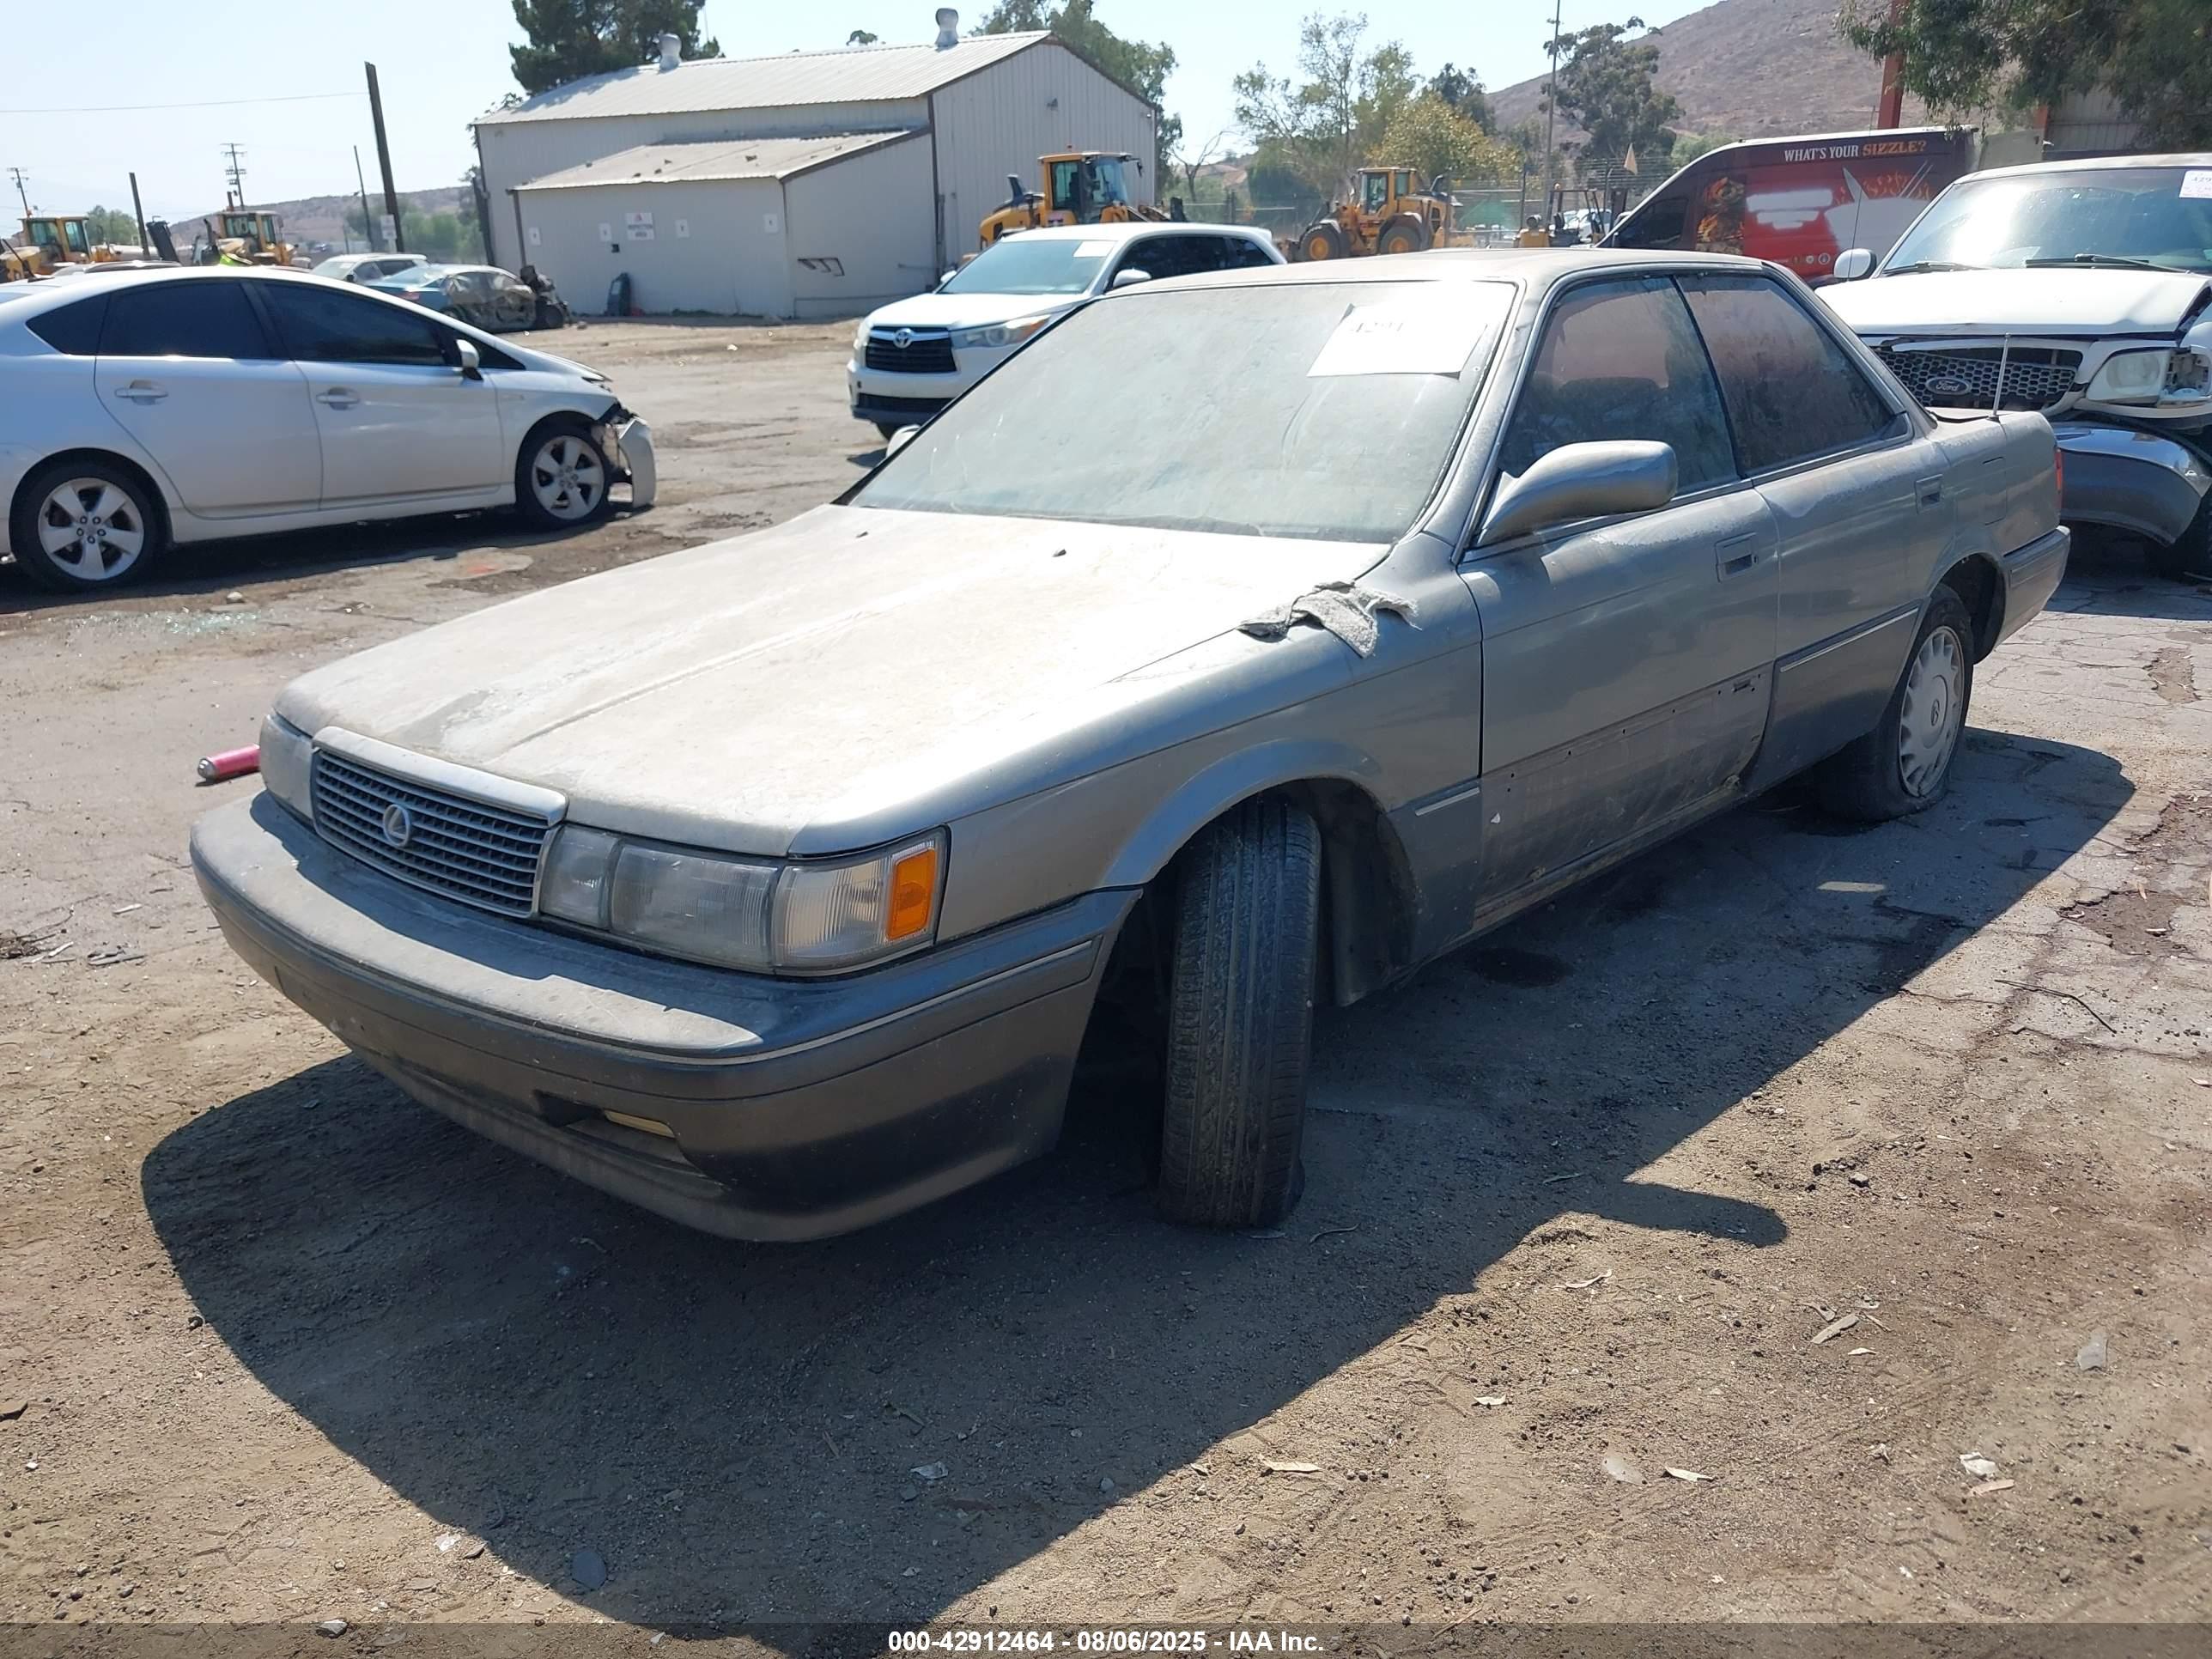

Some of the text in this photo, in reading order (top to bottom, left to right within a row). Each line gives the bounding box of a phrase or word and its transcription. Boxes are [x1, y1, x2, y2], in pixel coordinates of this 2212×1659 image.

[1784, 140, 1927, 162] WHAT'S YOUR SIZZLE?
